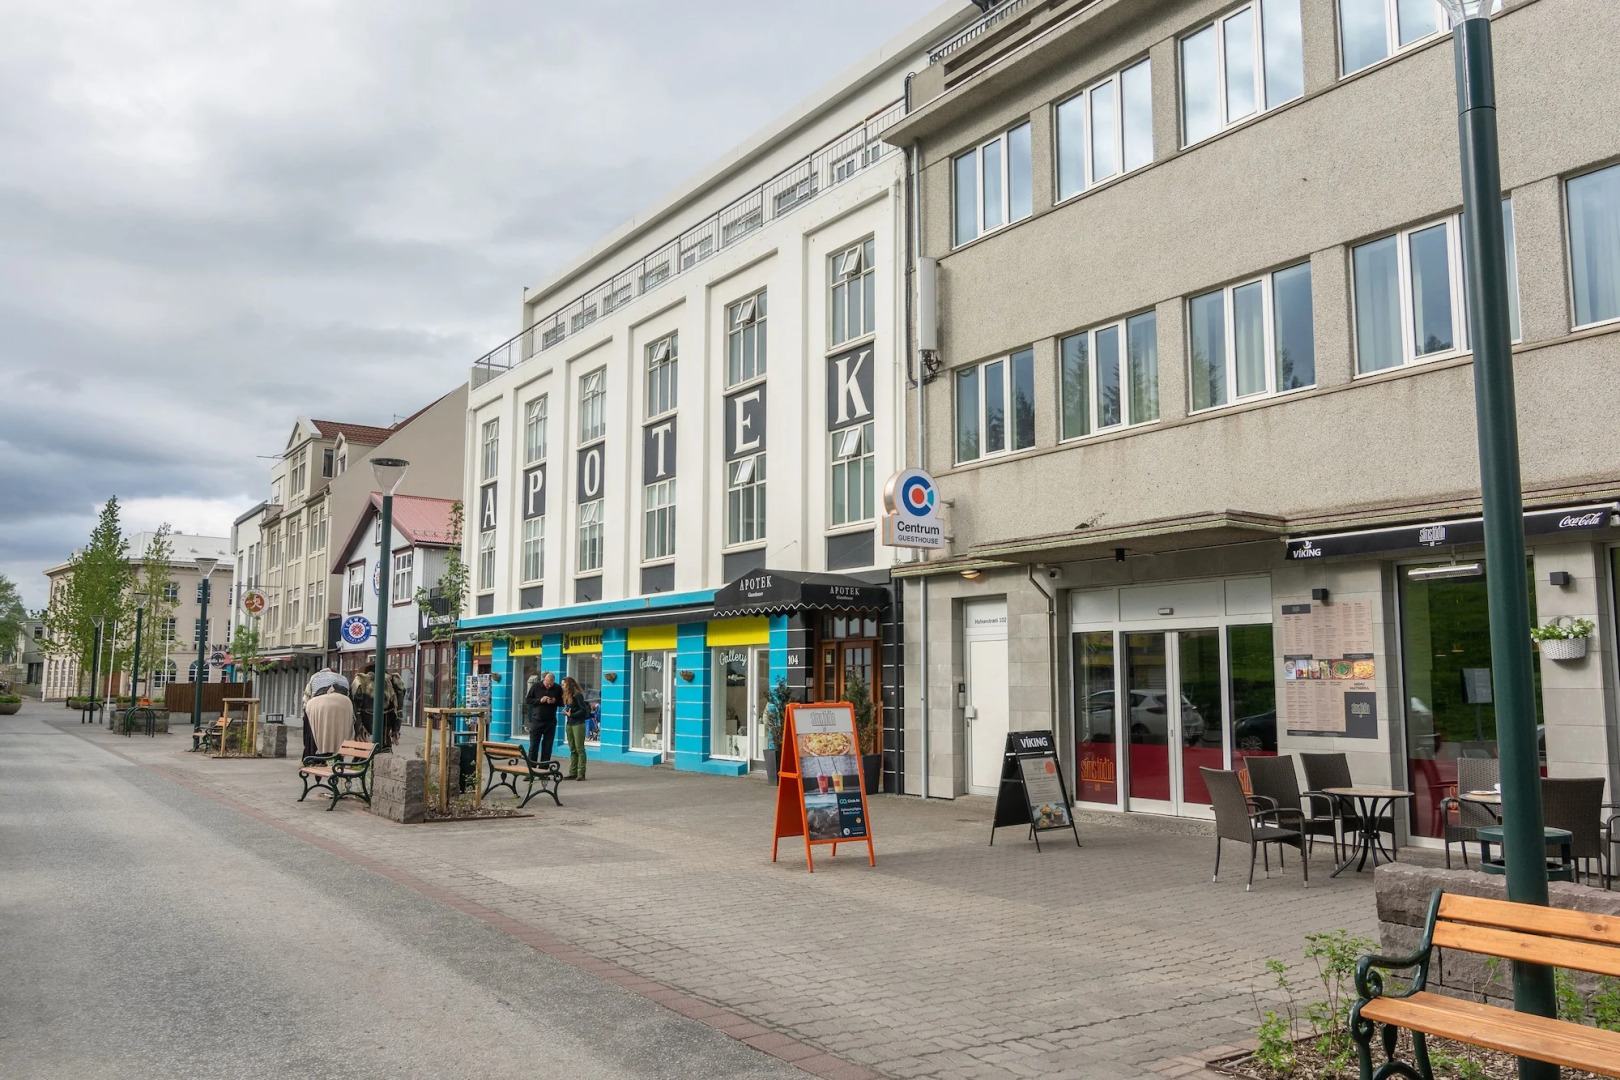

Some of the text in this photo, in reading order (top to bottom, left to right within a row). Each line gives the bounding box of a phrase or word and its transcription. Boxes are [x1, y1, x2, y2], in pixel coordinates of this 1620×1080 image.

[482, 349, 871, 529] APOTEK
[897, 520, 940, 535] Centrum
[898, 534, 939, 545] GUESTHOUSE
[739, 575, 772, 591] APOTEK
[829, 586, 860, 596] APOTEK
[639, 656, 663, 673] Gallery
[720, 650, 748, 667] Gallery
[787, 654, 799, 666] 104
